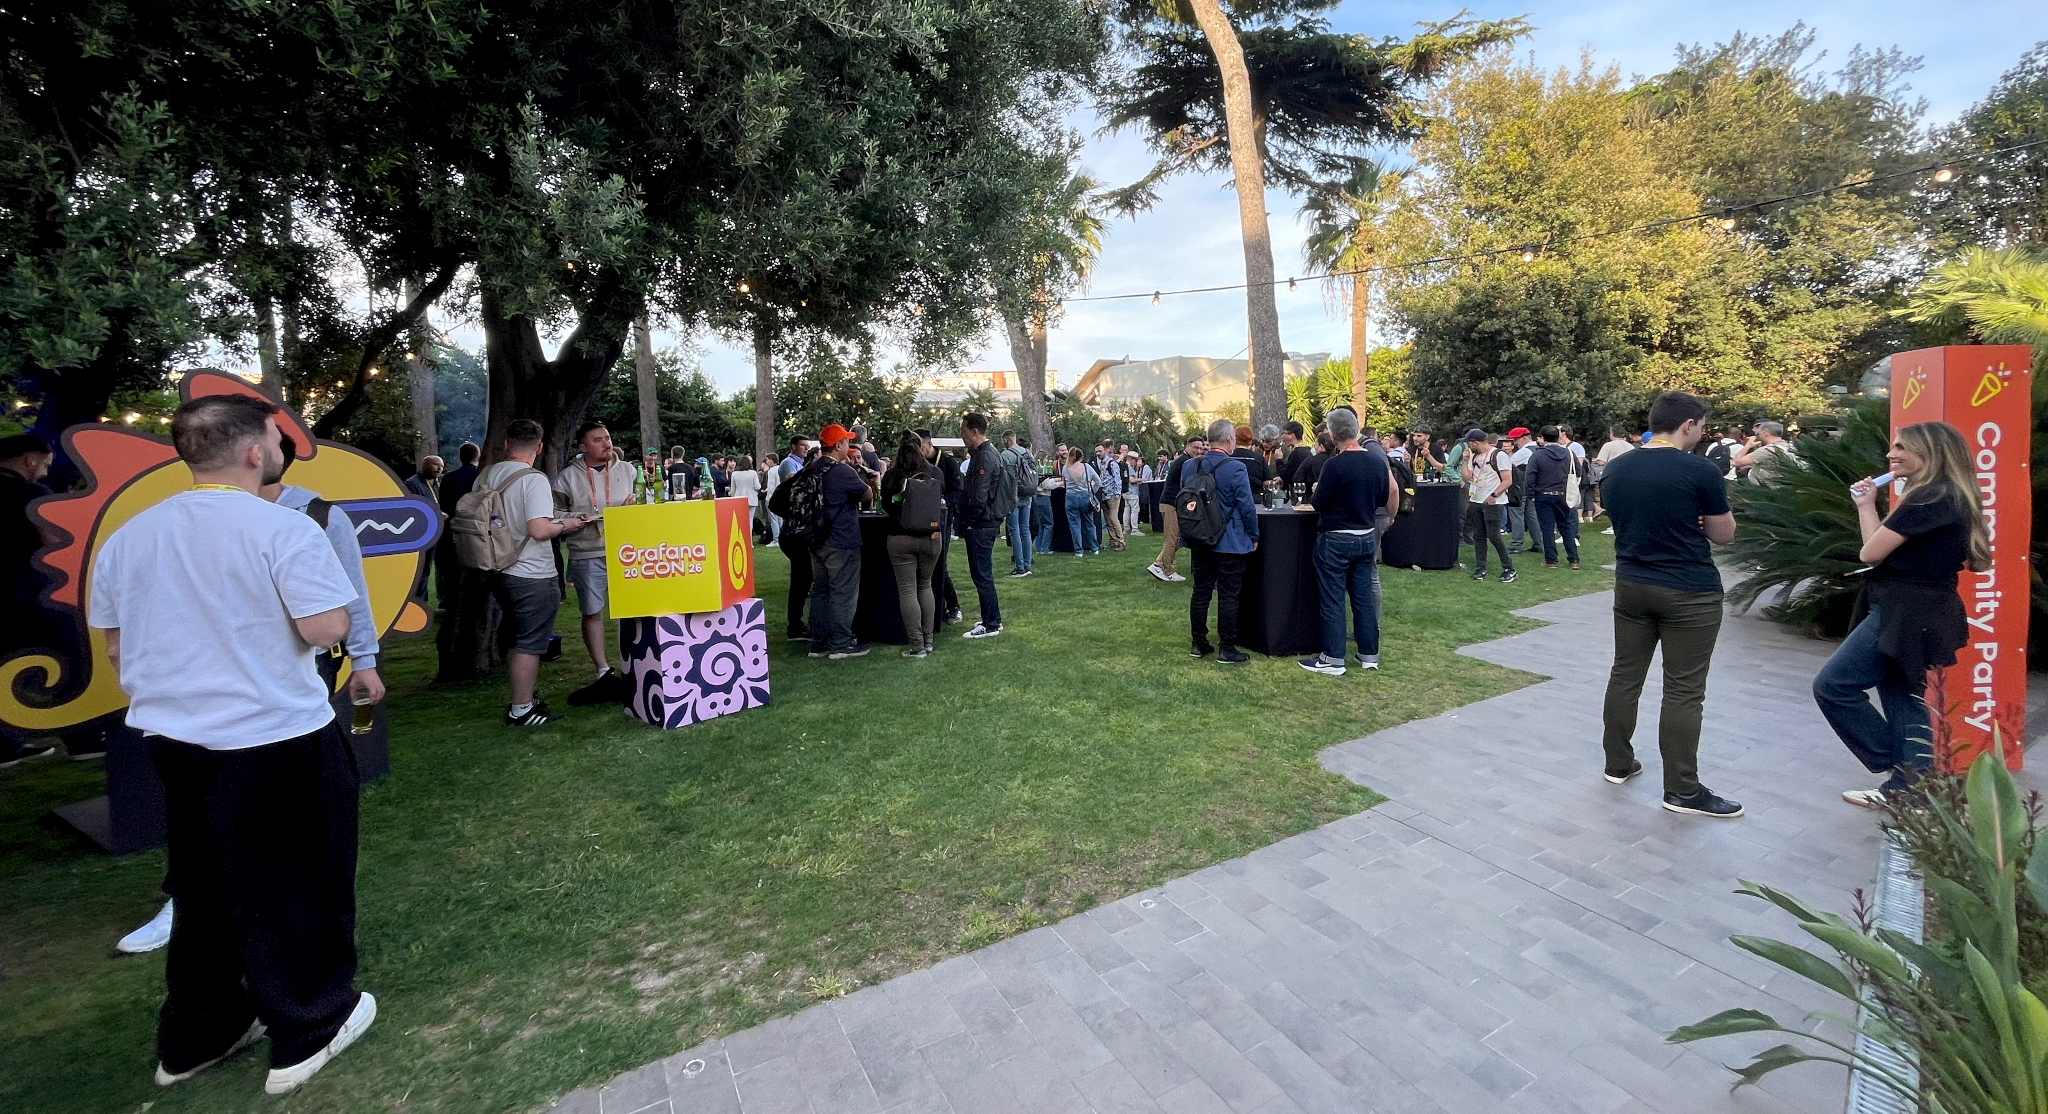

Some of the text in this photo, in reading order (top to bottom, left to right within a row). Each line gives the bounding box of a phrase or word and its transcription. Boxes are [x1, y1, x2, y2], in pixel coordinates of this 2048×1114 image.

[618, 542, 706, 566] Grafana
[624, 560, 703, 579] 20 CON 26
[1964, 422, 2002, 732] Commnity Party
